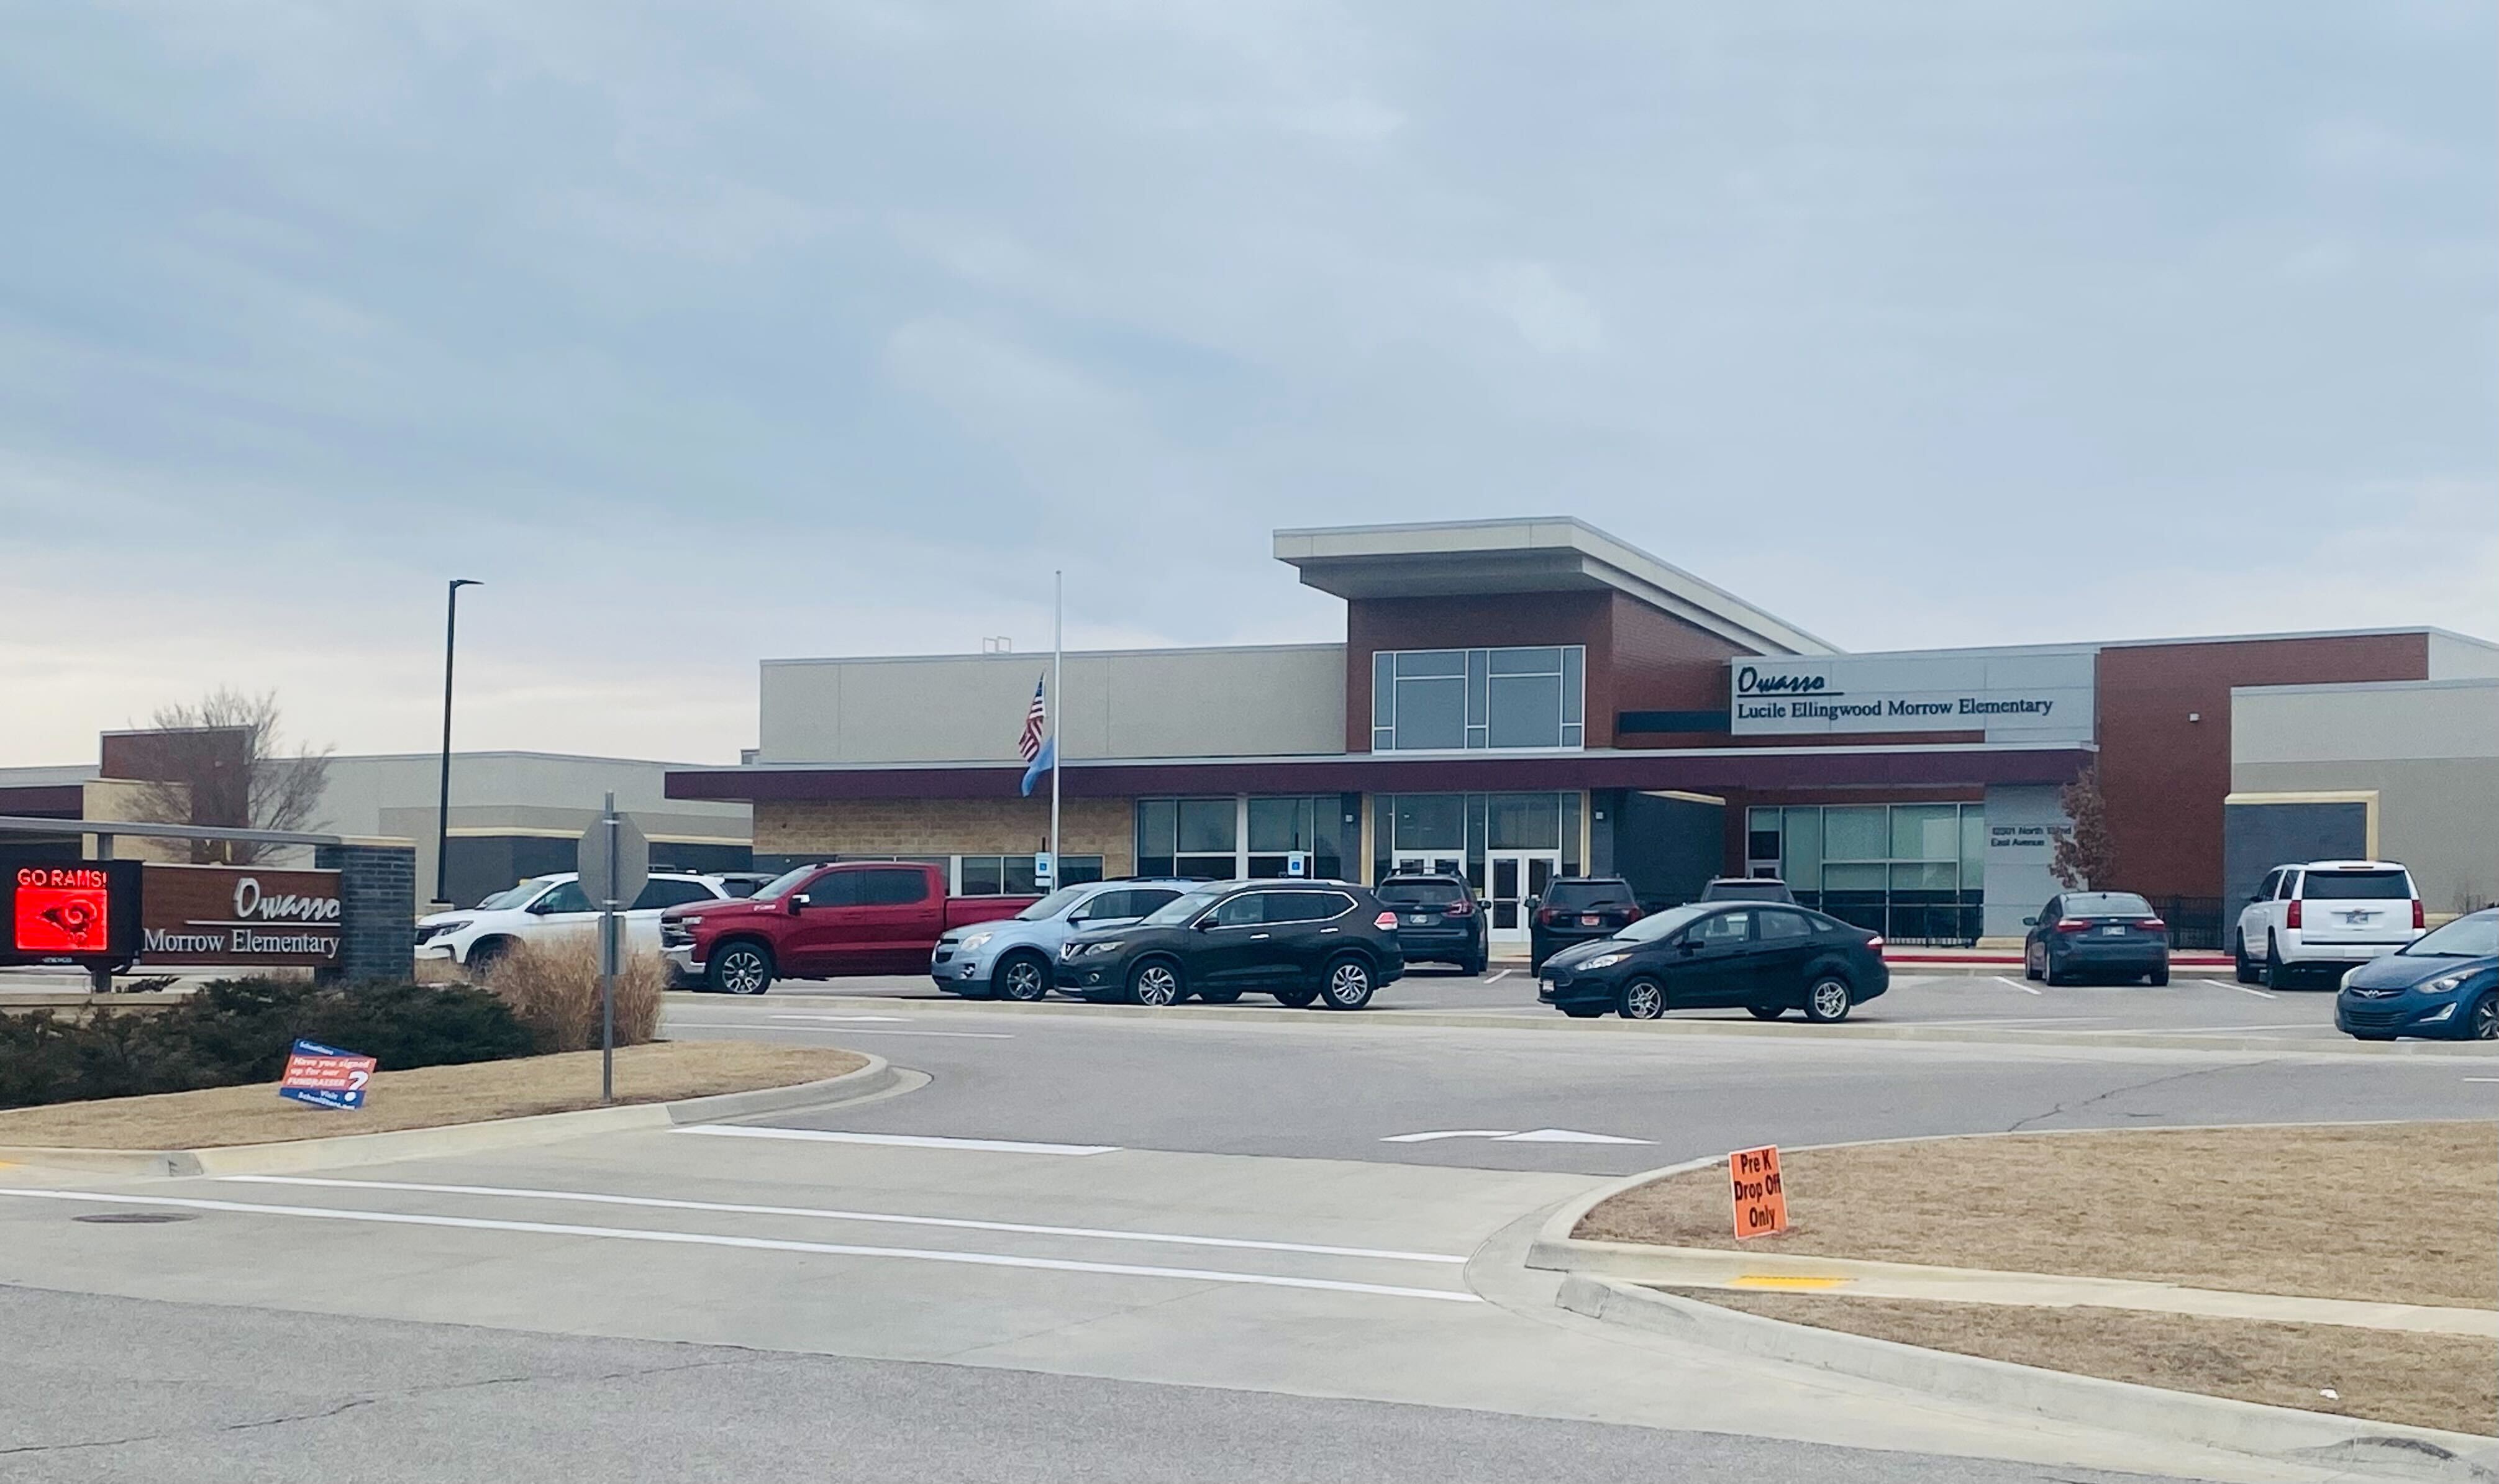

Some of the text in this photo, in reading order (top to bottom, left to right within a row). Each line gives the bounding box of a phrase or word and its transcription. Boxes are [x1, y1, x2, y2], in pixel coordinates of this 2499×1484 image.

[1738, 667, 1824, 693] Owasso
[1737, 698, 2053, 721] Lucile Ellingwood Morrow Elementary
[1991, 839, 2010, 847] East
[2018, 827, 2044, 835] North
[17, 868, 107, 888] GO RAMS!
[234, 878, 341, 919] Owasso
[143, 928, 340, 958] Morrow Elementary
[287, 1077, 346, 1087] FUNDRAISER
[1741, 1149, 1772, 1175] Pre K
[1734, 1173, 1782, 1203] Drop Off
[1749, 1204, 1775, 1230] Only
